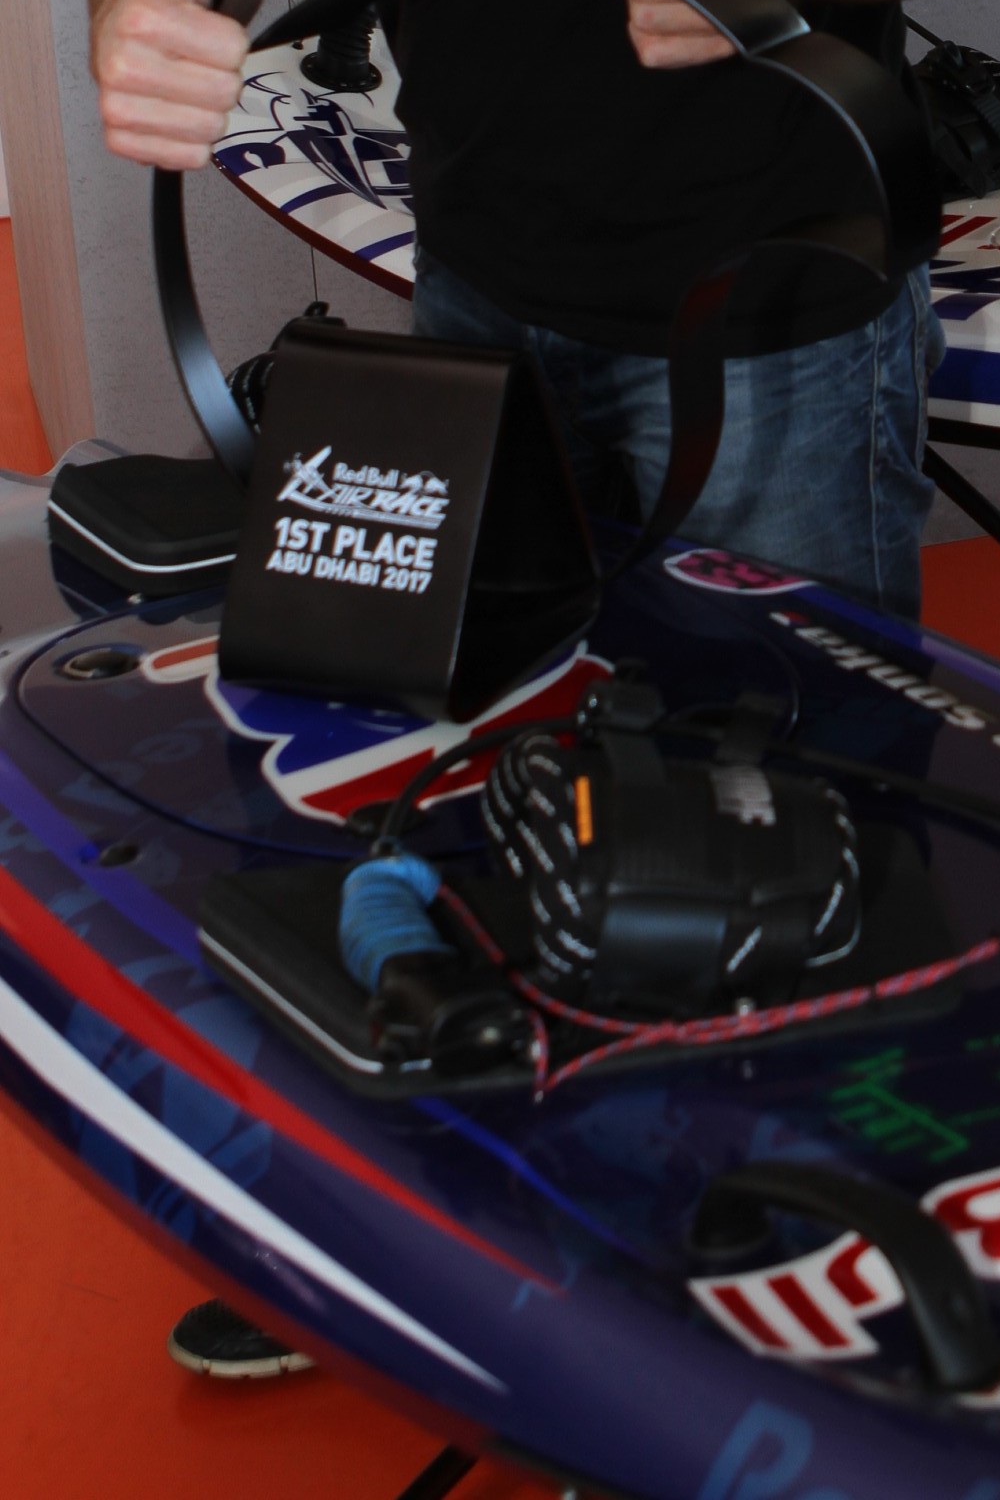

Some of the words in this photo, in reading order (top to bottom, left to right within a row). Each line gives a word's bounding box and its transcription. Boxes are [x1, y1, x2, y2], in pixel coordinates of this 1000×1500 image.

[333, 461, 367, 484] Red
[366, 466, 399, 489] Bull
[371, 488, 450, 520] RACE
[274, 516, 331, 553] 1ST
[332, 525, 438, 570] PLACE
[266, 549, 314, 576] ABU
[313, 555, 381, 587] DHABI
[381, 566, 433, 595] 2017
